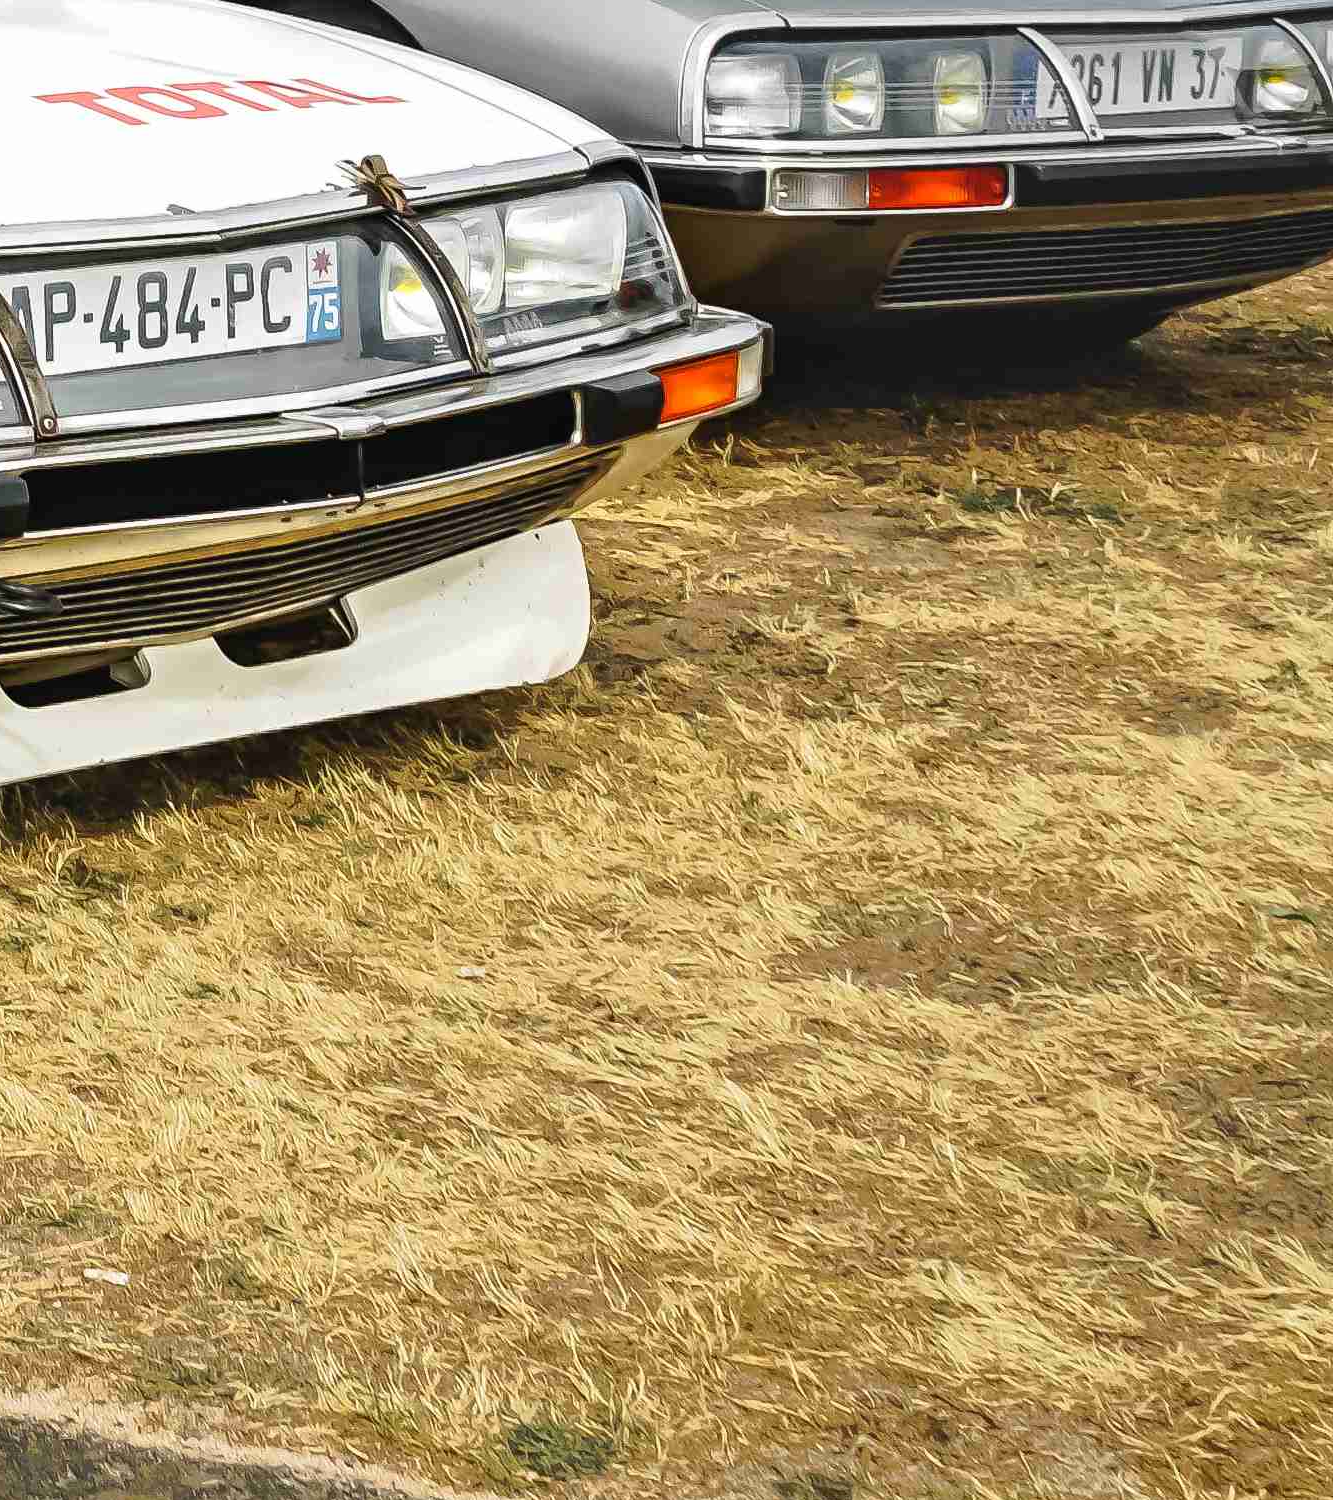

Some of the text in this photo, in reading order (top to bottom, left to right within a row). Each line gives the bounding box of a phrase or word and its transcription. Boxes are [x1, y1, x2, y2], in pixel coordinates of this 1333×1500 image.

[1142, 48, 1176, 103] VN
[1190, 46, 1228, 100] 37
[32, 78, 410, 126] TOTAL
[309, 293, 341, 335] 75
